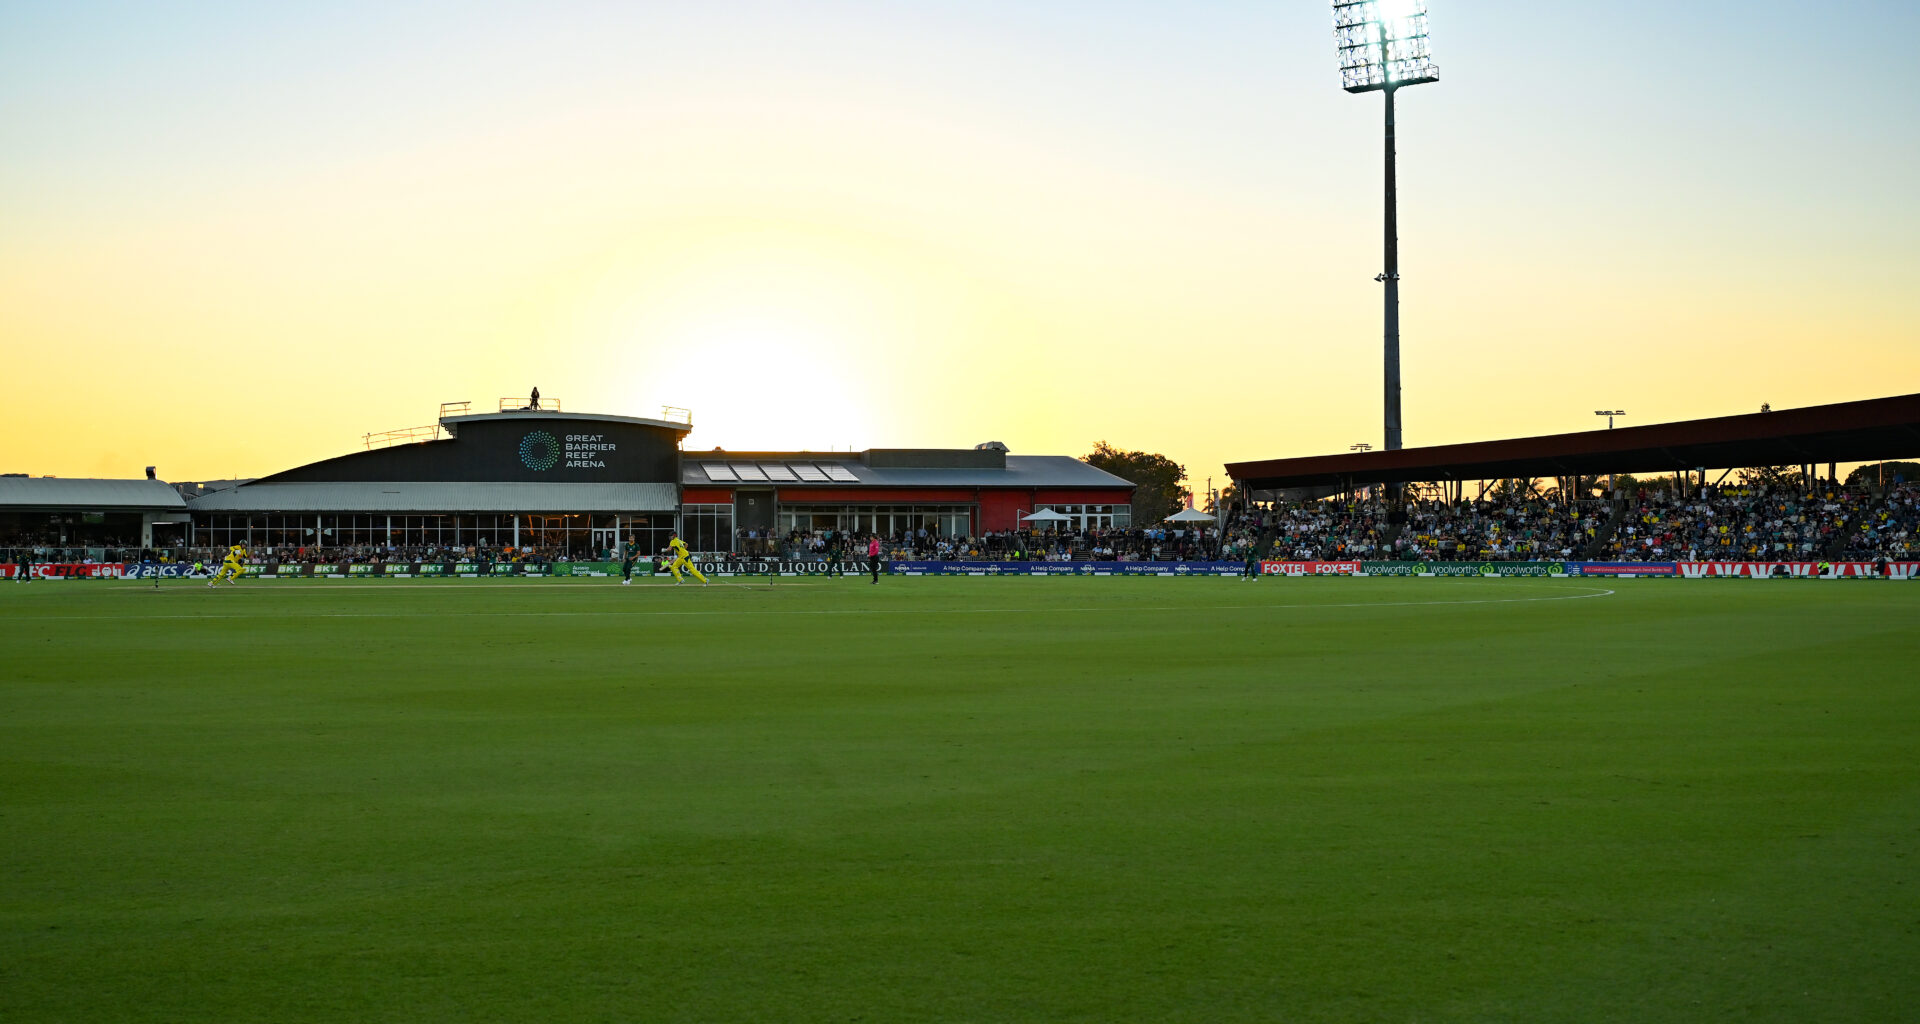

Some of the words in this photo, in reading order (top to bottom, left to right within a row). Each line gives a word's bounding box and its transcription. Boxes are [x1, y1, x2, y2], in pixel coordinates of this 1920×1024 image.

[565, 434, 604, 442] GREAT
[565, 443, 616, 451] BARRIER
[565, 460, 606, 468] ARENA
[278, 565, 302, 573] BKT
[314, 565, 339, 573] BKT
[350, 565, 374, 573] BKT
[385, 565, 410, 573] BKT
[420, 565, 444, 573] BKT
[455, 564, 479, 573] BKT
[1264, 564, 1308, 574] FOXTEL
[1363, 565, 1411, 574] Woolworths
[1430, 565, 1479, 574] Woolworths
[1497, 565, 1547, 574] Woolworths
